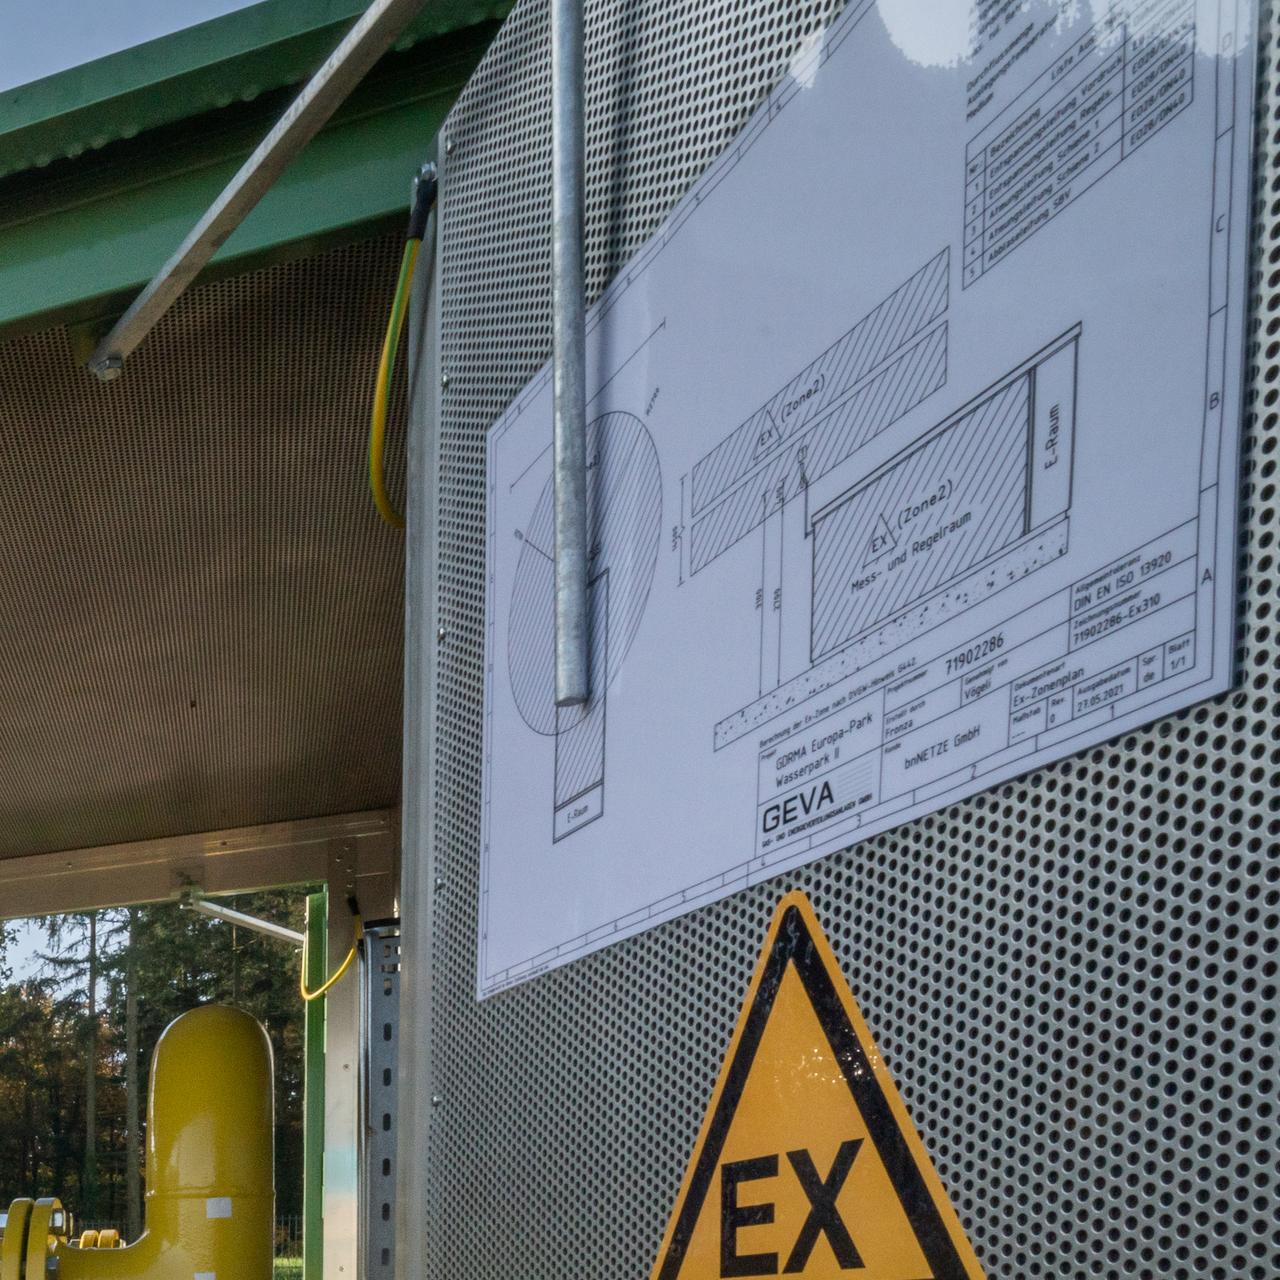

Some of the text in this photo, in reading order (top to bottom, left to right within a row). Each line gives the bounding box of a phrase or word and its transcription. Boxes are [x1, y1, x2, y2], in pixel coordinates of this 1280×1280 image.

[780, 373, 825, 423] (Zone2)
[1209, 391, 1220, 411] B
[1044, 403, 1059, 470] E-Raum
[871, 478, 953, 553] EX (Zone2)
[850, 511, 972, 595] Mess- und Regelraum
[1073, 551, 1172, 612] DIN EN ISO 13920
[1200, 567, 1213, 585] A
[1072, 592, 1161, 645] 71902286-Ex310
[1073, 589, 1142, 630] Zeichnungsnummer
[945, 632, 1004, 676] 71902286
[1168, 639, 1190, 654] Blatt
[1170, 655, 1186, 671] 1/1
[1013, 667, 1085, 708] Ex-Zonenplan
[1014, 661, 1065, 692] Dokumentenart
[1077, 666, 1131, 696] Ausgabedatum
[1143, 672, 1155, 683] de
[811, 711, 873, 753] Europa-Park
[885, 719, 913, 740] Fronza
[904, 724, 981, 770] bnNETZE GmbH
[776, 754, 830, 788] Wasserpark
[762, 780, 834, 833] GEVA
[719, 1137, 867, 1280] EX
